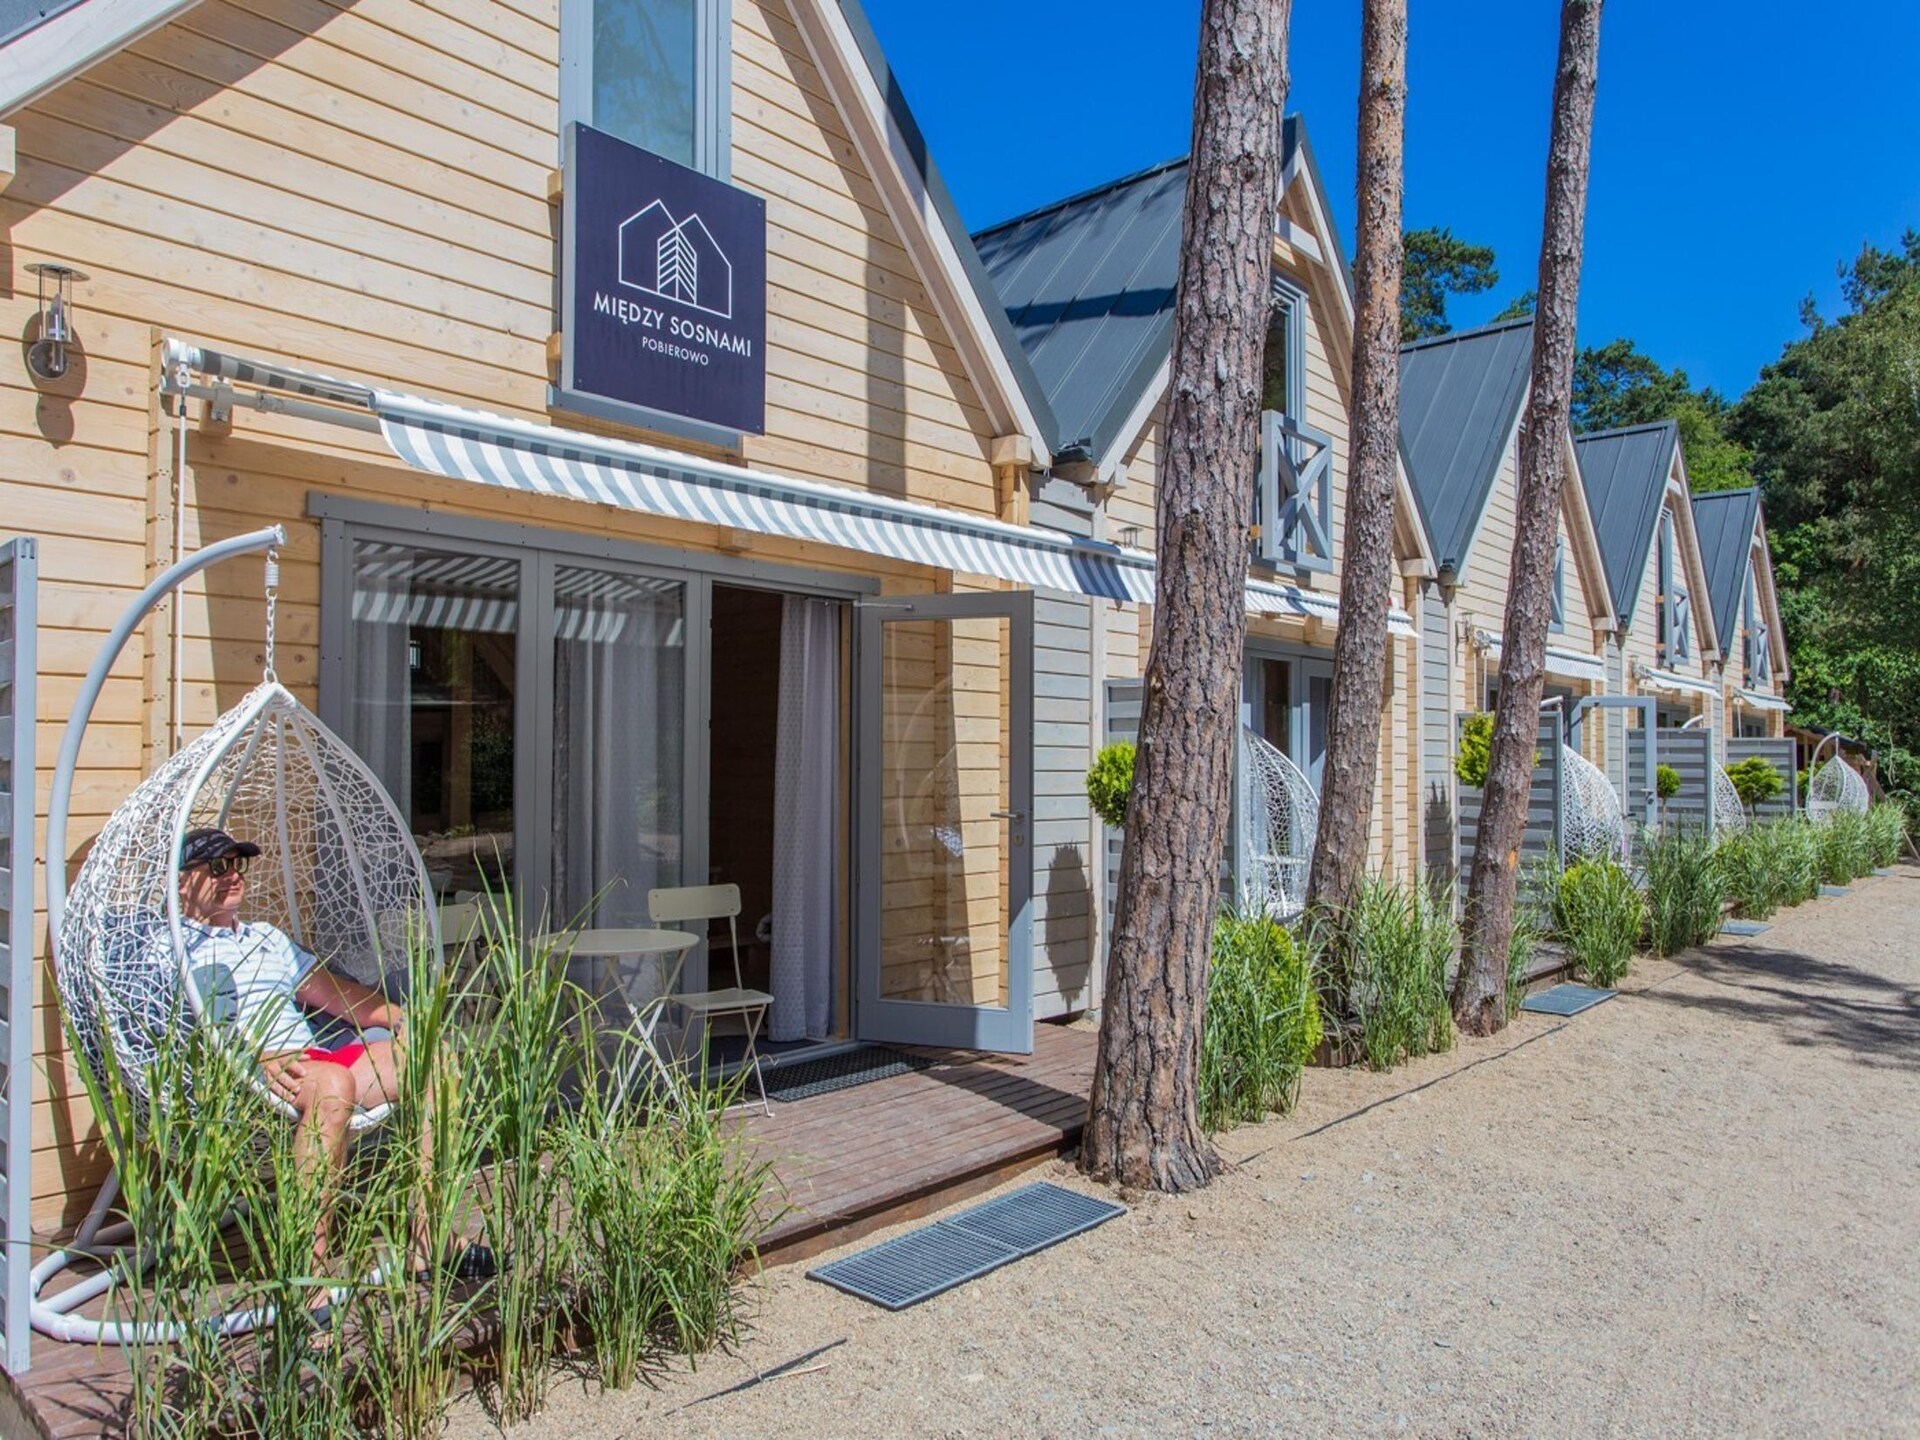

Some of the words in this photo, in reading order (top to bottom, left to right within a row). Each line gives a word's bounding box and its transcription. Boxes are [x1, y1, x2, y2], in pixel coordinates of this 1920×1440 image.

[593, 291, 665, 328] MIĘDZY
[670, 316, 751, 357] SOSNAMI
[642, 336, 709, 366] POBIEROWO
